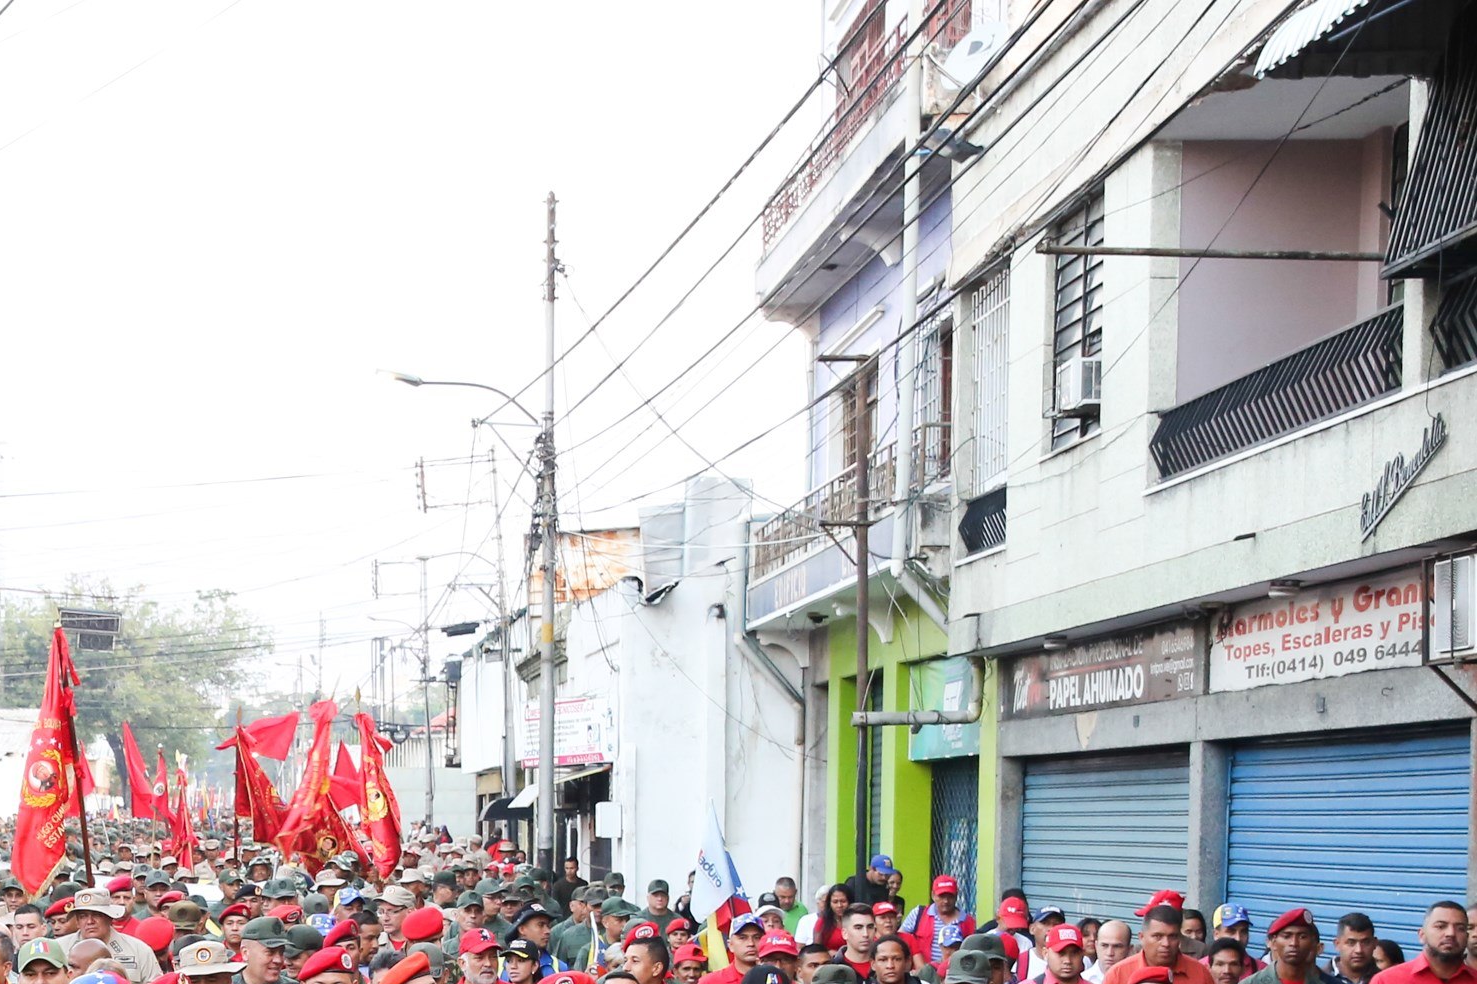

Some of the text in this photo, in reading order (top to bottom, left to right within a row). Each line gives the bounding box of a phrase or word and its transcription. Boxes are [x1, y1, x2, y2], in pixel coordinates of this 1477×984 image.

[1331, 596, 1343, 623] y
[1225, 641, 1275, 662] Topes,
[1281, 622, 1373, 651] Escaleras
[1380, 619, 1391, 640] y
[1334, 647, 1367, 666] 049
[1374, 639, 1422, 660] 6444
[1049, 664, 1144, 710] PAPEL AHUMADO
